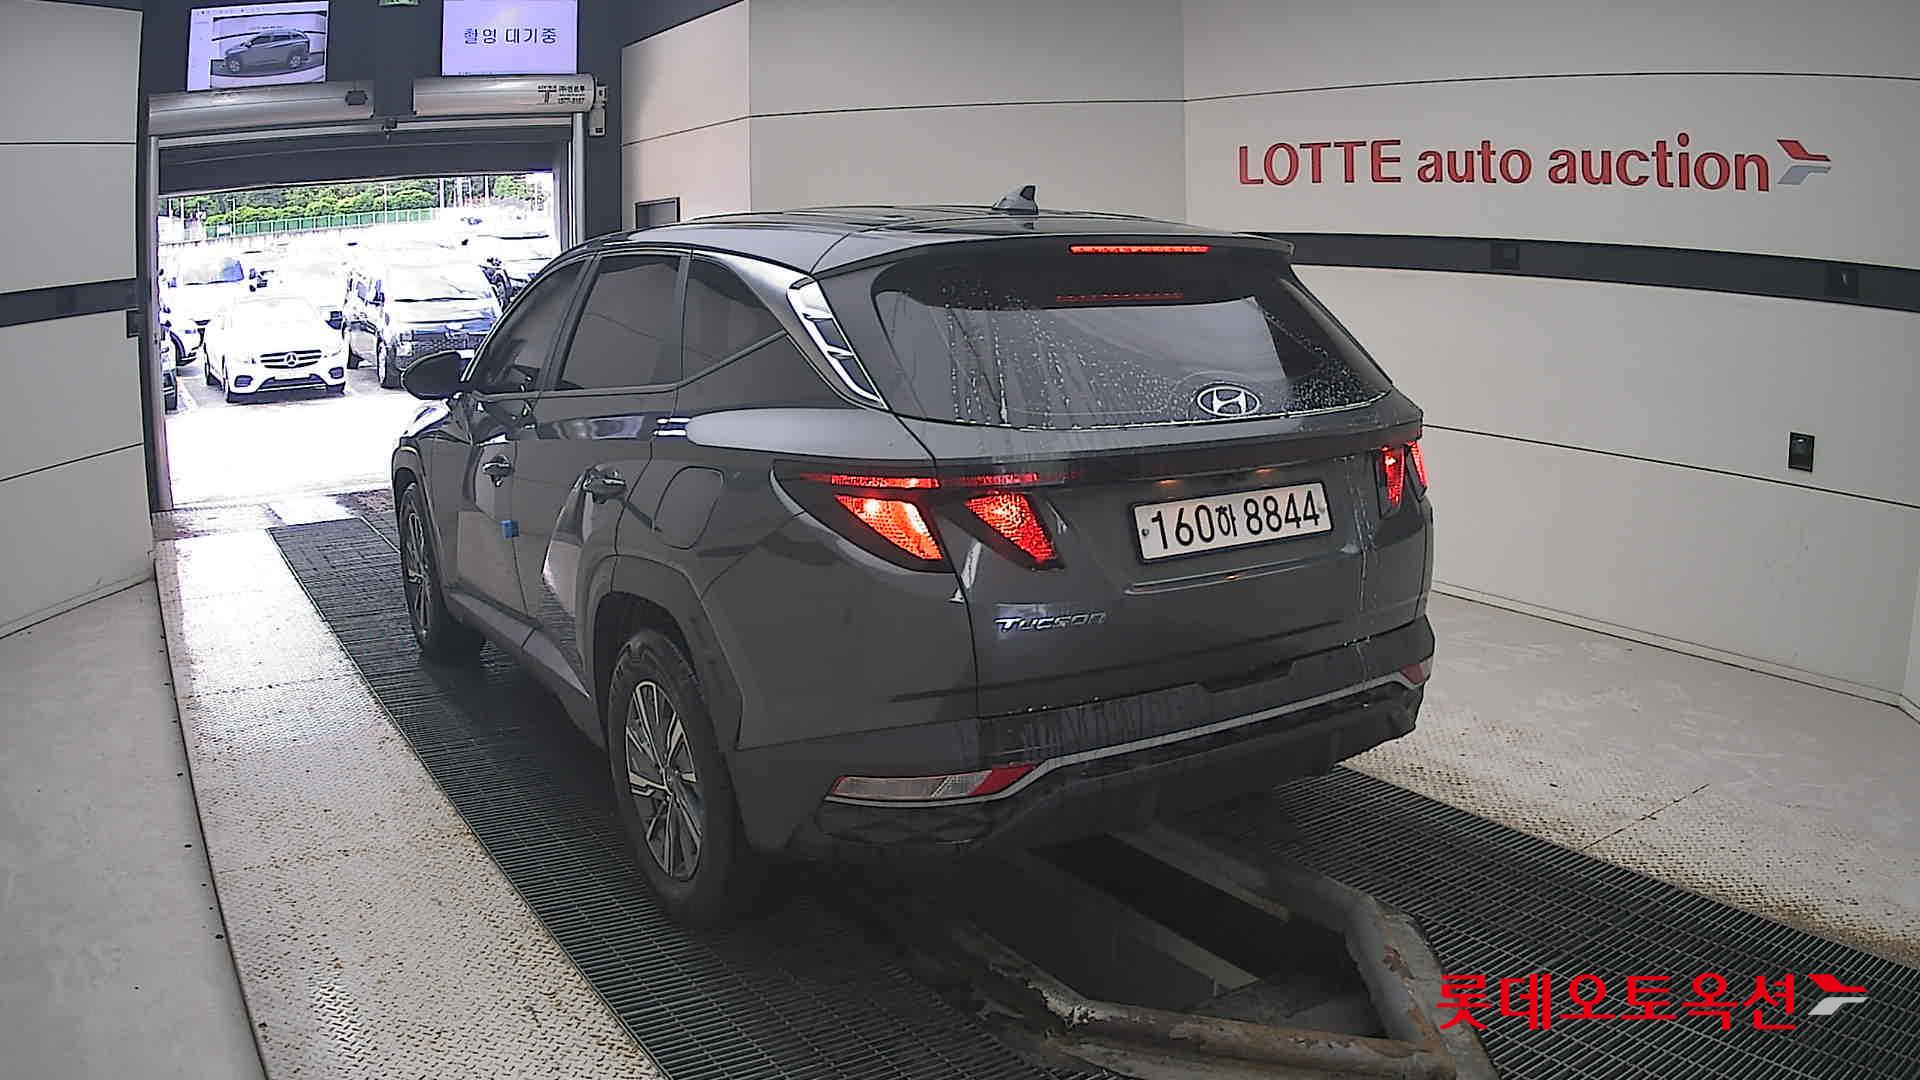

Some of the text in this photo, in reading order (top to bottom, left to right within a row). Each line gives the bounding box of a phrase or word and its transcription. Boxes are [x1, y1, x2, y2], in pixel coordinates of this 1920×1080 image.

[505, 28, 557, 44] 대기중
[1239, 131, 1770, 192] LOTTE auto auction
[1152, 489, 1321, 550] 160하 8844
